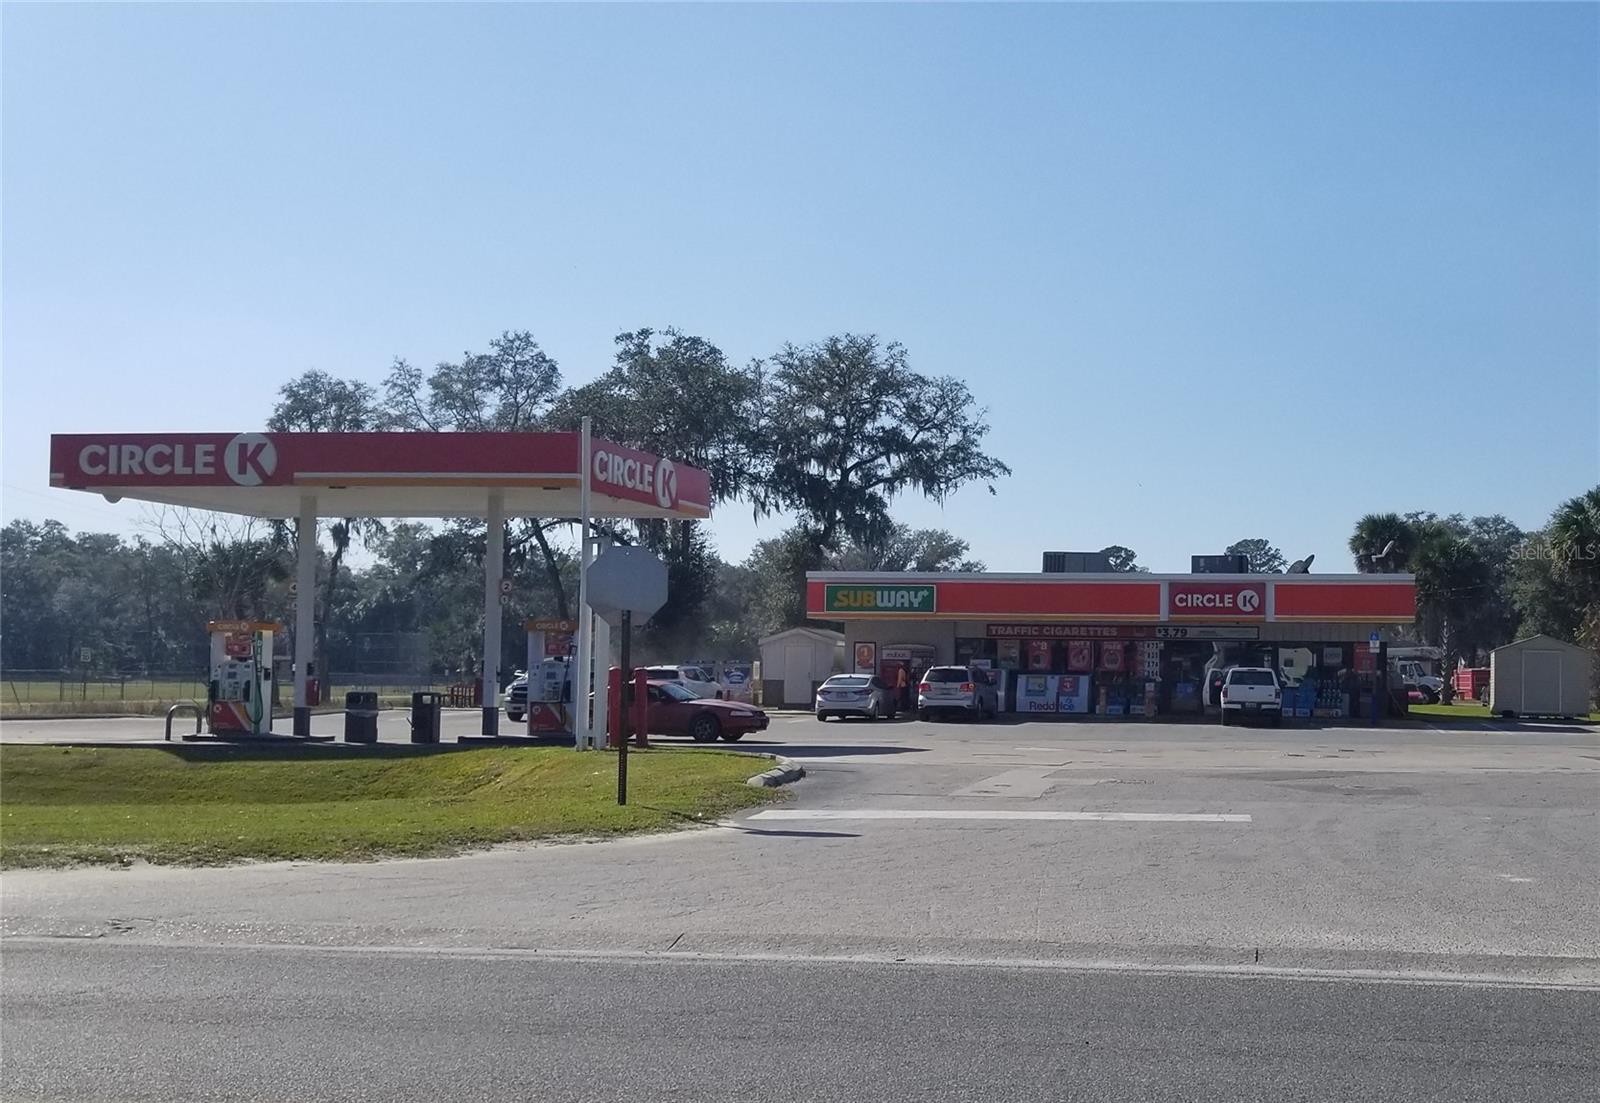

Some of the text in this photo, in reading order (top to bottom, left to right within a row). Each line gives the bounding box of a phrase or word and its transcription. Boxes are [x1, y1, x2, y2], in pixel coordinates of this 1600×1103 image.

[79, 443, 217, 476] CIRCLE
[592, 450, 654, 493] CIRCLE
[833, 590, 929, 608] SUBWAY
[1174, 593, 1234, 608] CIRCLE
[990, 626, 1118, 637] TRAFFIC CIGARETTES
